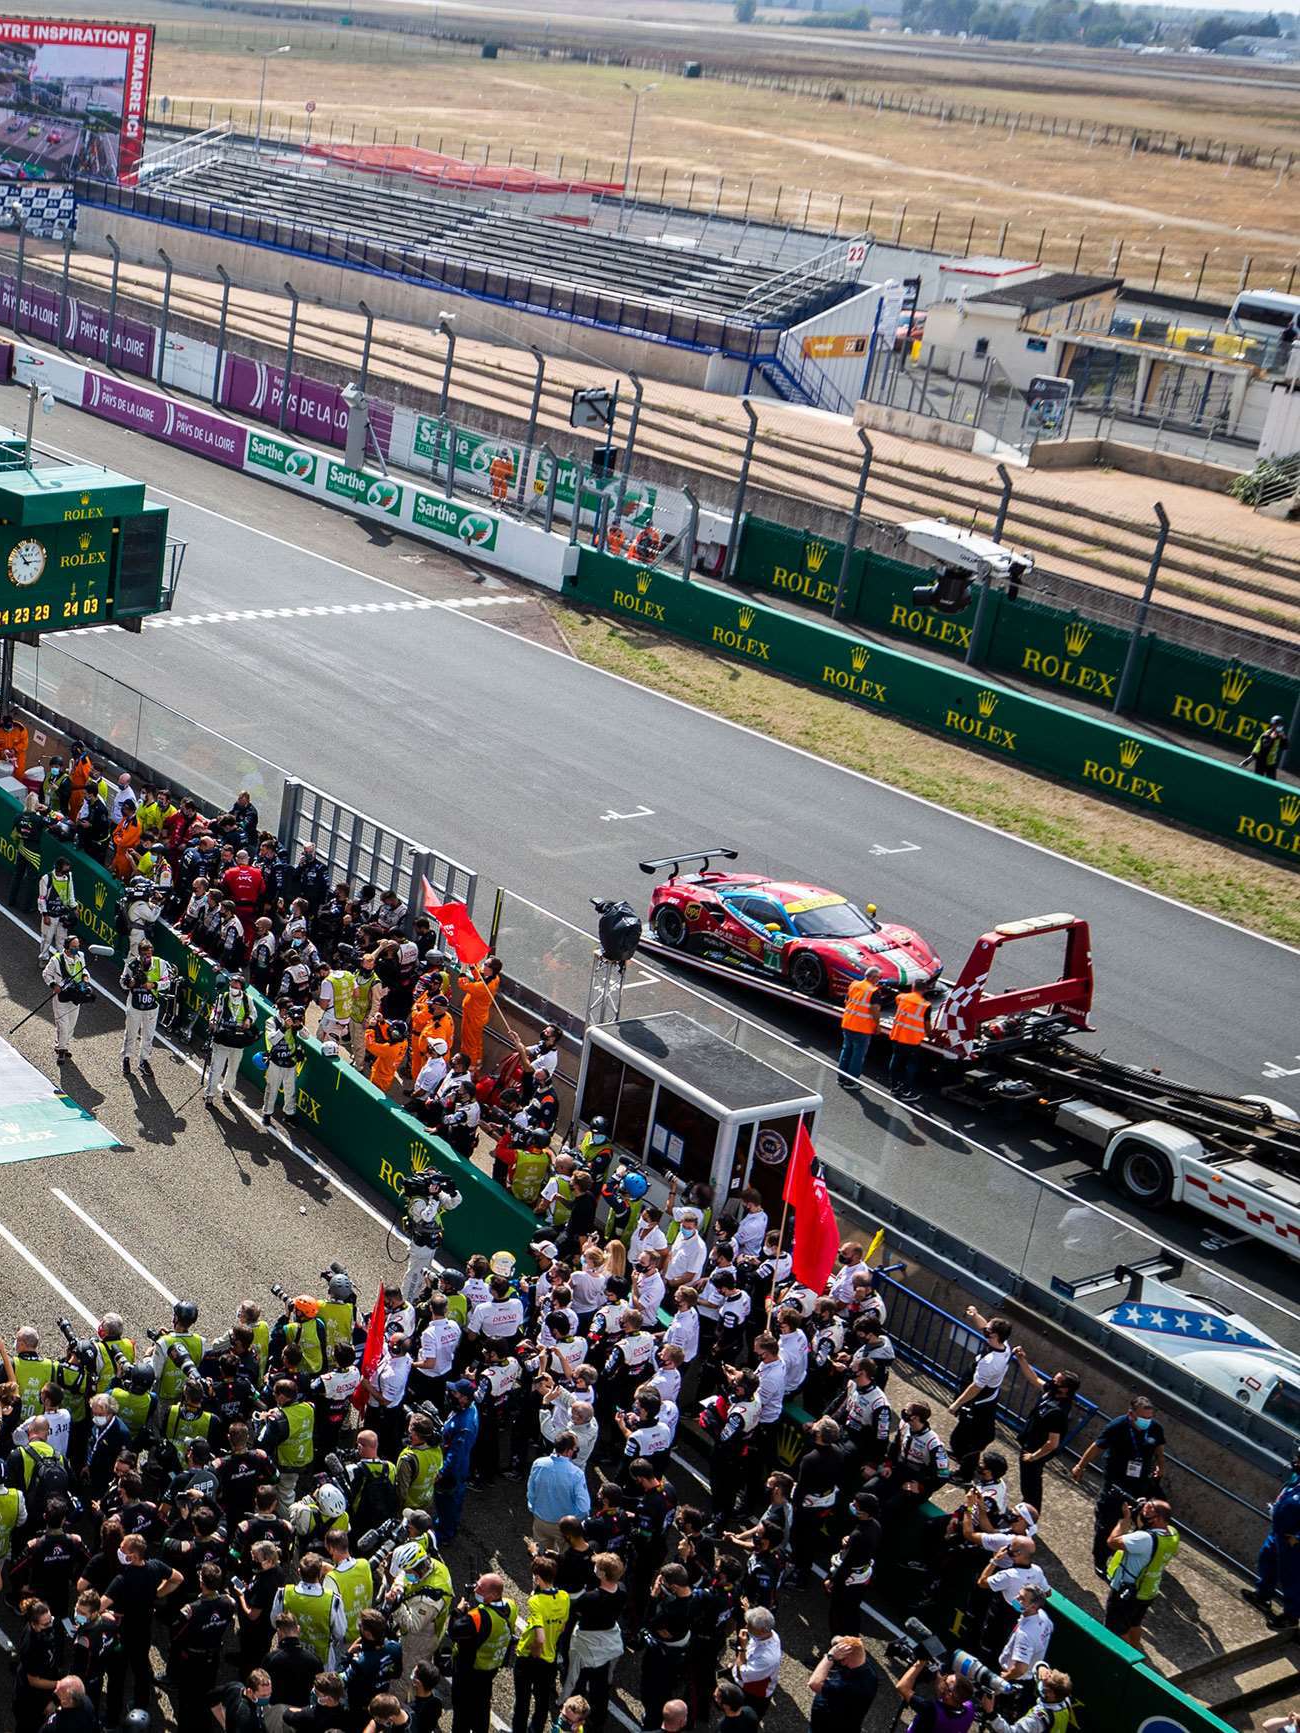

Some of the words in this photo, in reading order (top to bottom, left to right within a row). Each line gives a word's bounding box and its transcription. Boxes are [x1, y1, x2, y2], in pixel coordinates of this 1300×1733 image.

[33, 23, 130, 45] INSPIRATION
[128, 32, 147, 112] DEMARRE
[848, 246, 865, 261] 22
[80, 321, 98, 340] PAYS
[123, 338, 145, 358] LOIRE
[102, 392, 116, 408] PAYS
[117, 398, 126, 412] DE
[127, 401, 135, 414] LA
[136, 404, 154, 423] LOIRE
[300, 395, 315, 416] DE
[317, 401, 330, 420] LA
[176, 421, 193, 437] PAYS
[193, 426, 204, 441] DE
[204, 430, 214, 445] LA
[214, 433, 235, 453] LOIRE
[251, 436, 284, 462] Sarthe
[330, 466, 366, 492] Sarthe
[64, 507, 103, 521] ROLEX
[417, 497, 457, 524] Sarthe
[60, 551, 106, 567] ROLEX
[772, 566, 845, 608] ROLEX
[613, 590, 665, 622] ROLEX
[891, 603, 973, 649] ROLEX
[712, 626, 770, 660] ROLEX
[823, 666, 887, 702] ROLEX
[1022, 647, 1116, 698] ROLEX
[945, 710, 1017, 751] ROLEX
[1082, 759, 1164, 804] ROLEX
[1236, 815, 1300, 852] ROLE
[76, 901, 117, 948] ROLEX
[764, 952, 781, 970] 71
